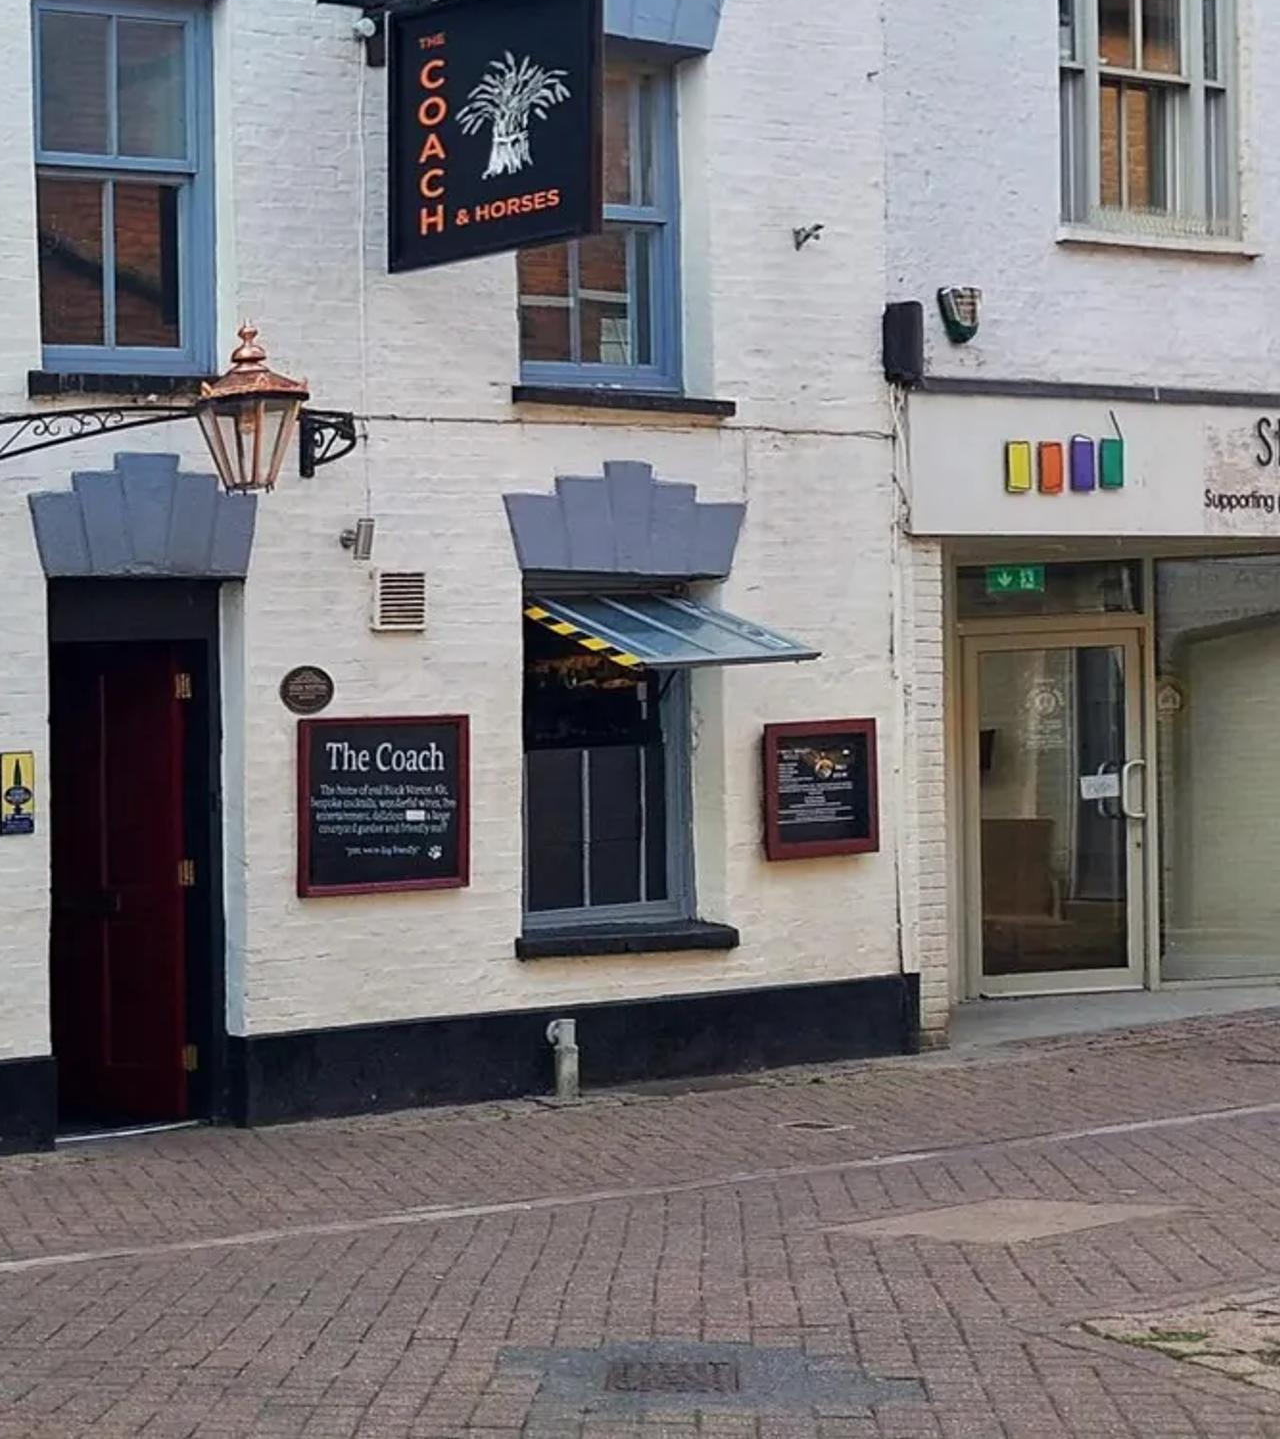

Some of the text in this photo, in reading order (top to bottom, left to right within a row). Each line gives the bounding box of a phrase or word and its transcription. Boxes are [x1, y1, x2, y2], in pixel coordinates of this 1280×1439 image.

[418, 33, 447, 50] THE
[418, 59, 447, 236] COACH
[455, 188, 561, 226] & HORSES
[1204, 488, 1275, 513] Supporting
[325, 742, 445, 772] The Coach
